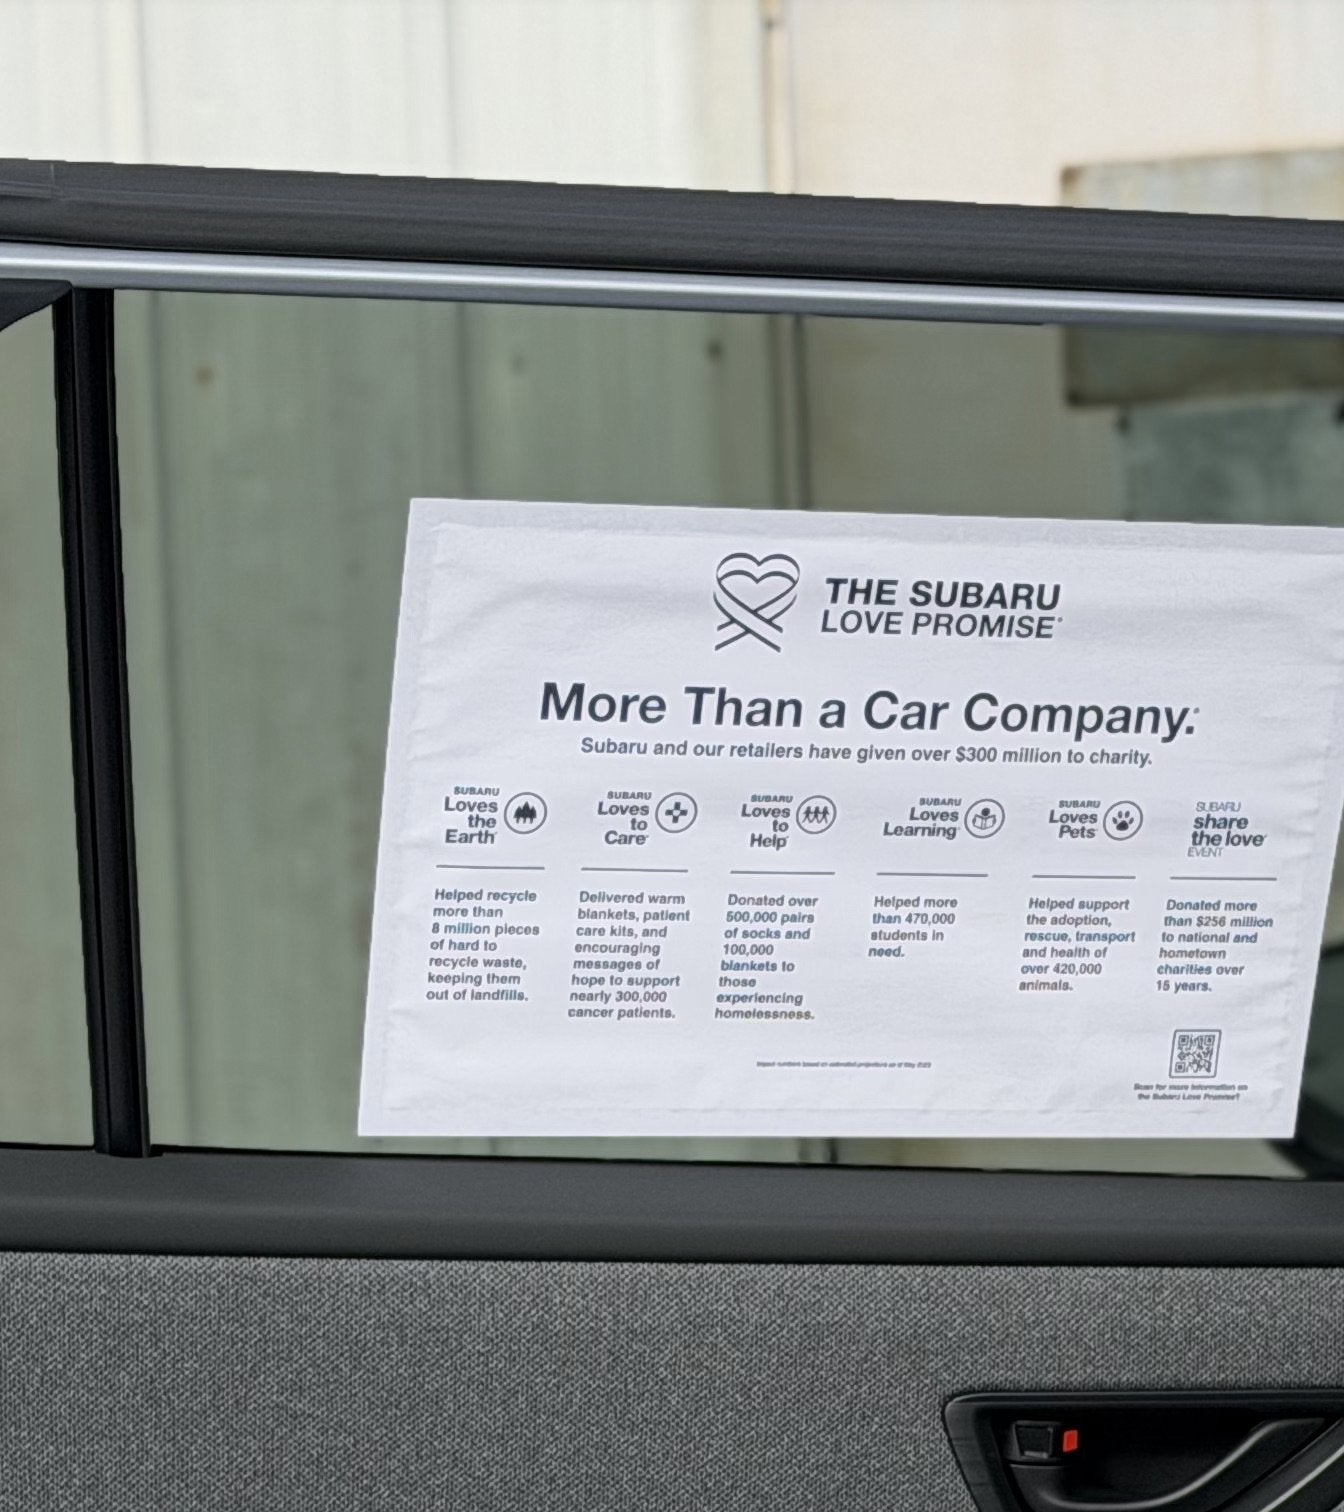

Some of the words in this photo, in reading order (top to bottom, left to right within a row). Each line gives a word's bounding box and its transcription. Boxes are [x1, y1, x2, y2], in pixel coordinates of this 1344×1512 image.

[826, 578, 898, 605] THE
[909, 580, 1060, 611] SUBARU
[821, 609, 903, 634] LOVE
[912, 612, 1055, 638] PROMISE
[541, 682, 666, 724] More
[684, 686, 802, 727] Than
[819, 700, 846, 728] a
[864, 690, 950, 730] Car
[964, 693, 1194, 743] Company.
[581, 737, 647, 754] Subaru
[653, 740, 688, 755] and
[693, 744, 725, 756] our
[730, 743, 803, 758] retailers
[809, 744, 851, 759] have
[857, 744, 905, 763] given
[912, 749, 951, 761] over
[956, 746, 997, 762] $300
[1003, 747, 1061, 763] million
[1068, 749, 1084, 763] to
[1090, 749, 1152, 768] charity.
[454, 786, 499, 796] SUBARU
[607, 791, 652, 800] SUBARU
[444, 796, 498, 813] Loves
[751, 794, 793, 803] SUBARU
[919, 798, 962, 806] SUBARU
[1059, 800, 1100, 808] SUBARU
[598, 801, 649, 816] Loves
[741, 804, 790, 818] Loves
[1196, 802, 1241, 812] SUBARU
[468, 814, 496, 828] the
[909, 807, 959, 822] Loves
[1049, 809, 1098, 824] Loves
[631, 818, 648, 831] to
[773, 819, 789, 832] to
[1193, 813, 1249, 830] share
[445, 829, 497, 844] Earth
[605, 830, 649, 845] Care
[883, 822, 957, 840] Learning
[1058, 824, 1096, 839] Pets
[750, 833, 789, 851] Help
[1192, 830, 1222, 846] the
[1225, 830, 1265, 847] love
[1188, 847, 1222, 857] EVENT
[435, 889, 483, 903] Helped
[487, 890, 537, 904] recycle
[580, 891, 644, 904] Delivered
[648, 895, 685, 904] warm
[728, 894, 785, 906] Donated
[788, 897, 818, 907] over
[874, 896, 920, 910] Helped
[924, 899, 957, 908] more
[433, 908, 468, 917] more
[473, 906, 503, 917] than
[1029, 898, 1075, 911] Helped
[1078, 899, 1129, 912] support
[1166, 899, 1221, 911] Donated
[1224, 903, 1257, 911] more
[578, 908, 639, 922] blankets,
[643, 910, 690, 923] patient
[726, 911, 777, 924] 500,000
[781, 912, 814, 926] pairs
[873, 913, 901, 924] than
[905, 913, 955, 925] 470,000
[1027, 914, 1047, 925] the
[1051, 914, 1111, 928] adoption,
[1164, 916, 1192, 926] than
[1196, 916, 1226, 927] $256
[1230, 917, 1273, 927] million
[432, 922, 439, 934] 8
[444, 923, 490, 934] million
[495, 923, 539, 937] pieces
[576, 927, 605, 936] care
[610, 925, 638, 938] kits,
[642, 926, 667, 938] and
[724, 927, 738, 938] of
[742, 928, 781, 939] socks
[785, 928, 810, 939] and
[871, 930, 927, 941] students
[932, 930, 944, 941] in
[1025, 932, 1072, 944] rescue,
[1076, 931, 1135, 944] transport
[1162, 932, 1174, 942] to
[1178, 932, 1230, 943] national
[1233, 932, 1258, 943] and
[430, 939, 445, 950] of
[448, 939, 479, 951] hard
[484, 940, 497, 951] to
[575, 942, 660, 956] encouraging
[724, 944, 774, 956] 100,000
[868, 946, 904, 957] need.
[1023, 947, 1047, 958] and
[1051, 947, 1090, 958] health
[1094, 947, 1107, 958] of
[1159, 947, 1226, 959] hometown
[429, 956, 478, 970] recycle
[483, 958, 526, 970] waste,
[573, 960, 642, 972] messages
[646, 959, 660, 970] of
[721, 960, 777, 971] blankets
[782, 961, 795, 972] to
[1021, 965, 1049, 974] over
[1053, 963, 1102, 976] 420,000
[1157, 964, 1212, 975] charities
[1216, 966, 1244, 975] over
[428, 972, 482, 987] keeping
[487, 973, 520, 984] them
[572, 974, 605, 988] hope
[610, 975, 623, 986] to
[627, 976, 680, 989] support
[719, 976, 756, 987] those
[1019, 979, 1073, 991] animals.
[1157, 980, 1170, 991] 15
[1174, 982, 1211, 994] years.
[426, 990, 448, 1000] out
[453, 989, 467, 1000] of
[471, 989, 528, 1001] landfills.
[570, 990, 611, 1004] nearly
[615, 991, 667, 1003] 300,000
[717, 992, 803, 1006] experiencing
[568, 1009, 614, 1017] cancer
[617, 1007, 675, 1020] patients.
[715, 1008, 814, 1020] homelessness.
